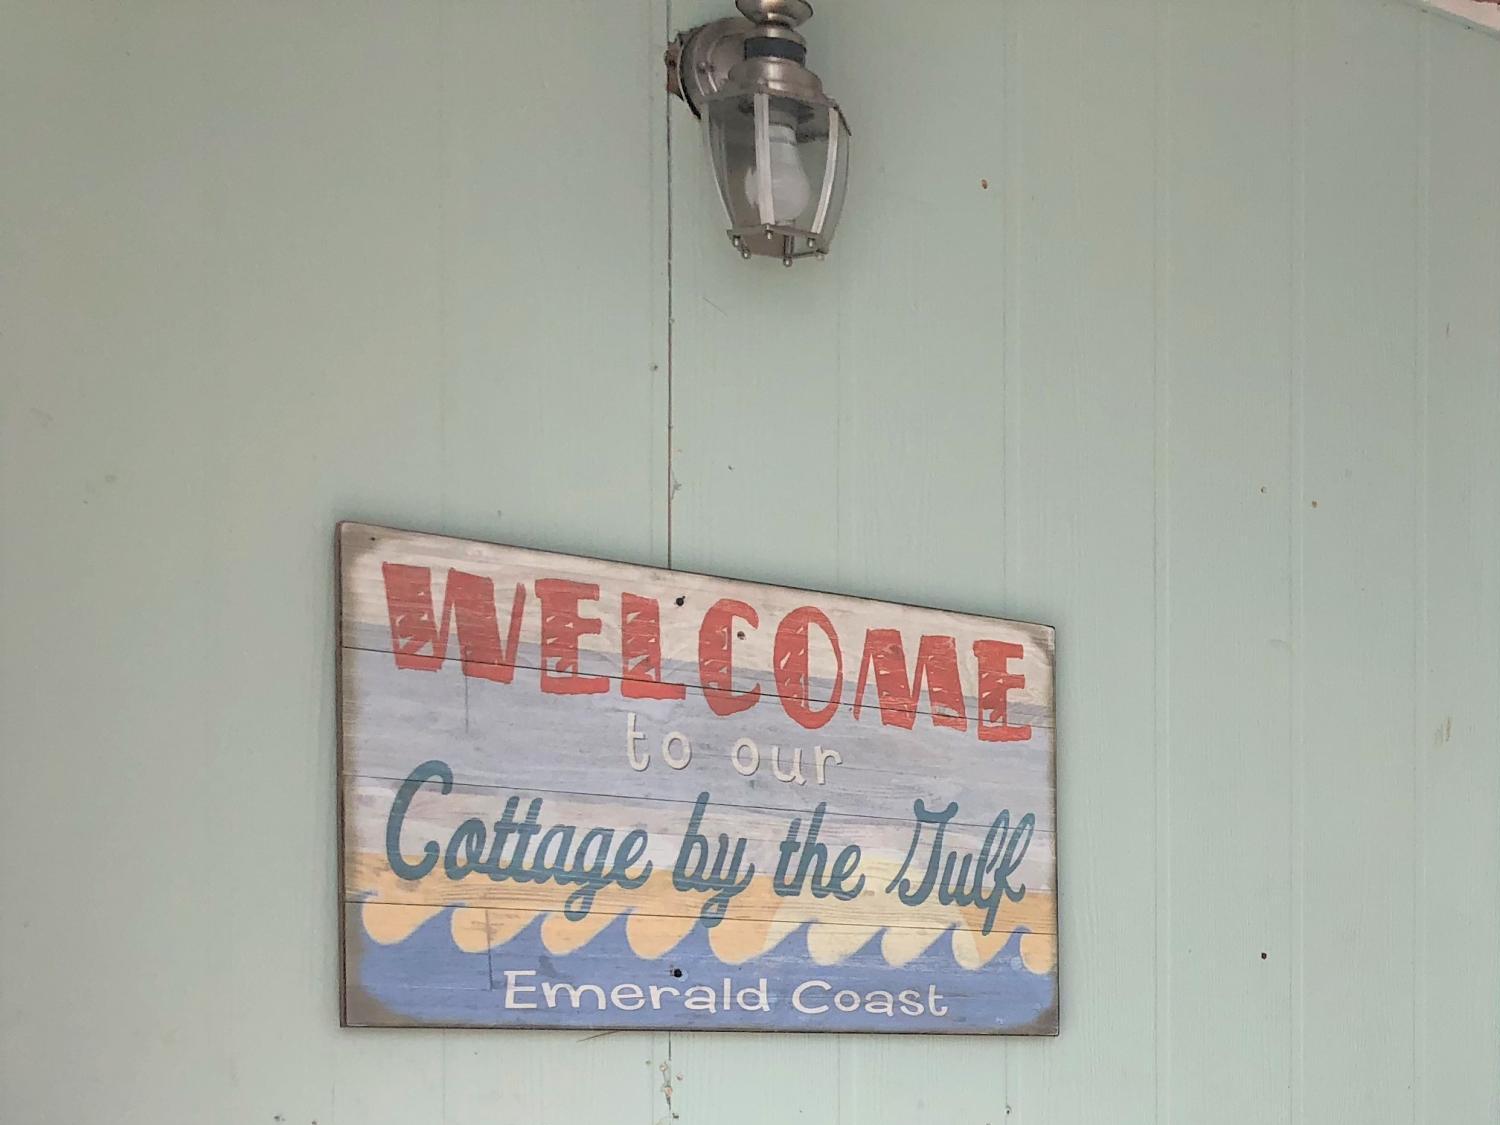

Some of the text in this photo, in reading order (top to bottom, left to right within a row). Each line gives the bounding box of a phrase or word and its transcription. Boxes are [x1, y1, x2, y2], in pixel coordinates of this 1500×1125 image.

[382, 561, 1033, 742] WELCOME
[626, 713, 844, 786] to our
[385, 759, 1037, 936] Cottage by the Gulf
[503, 969, 949, 1017] Emerald Coast
